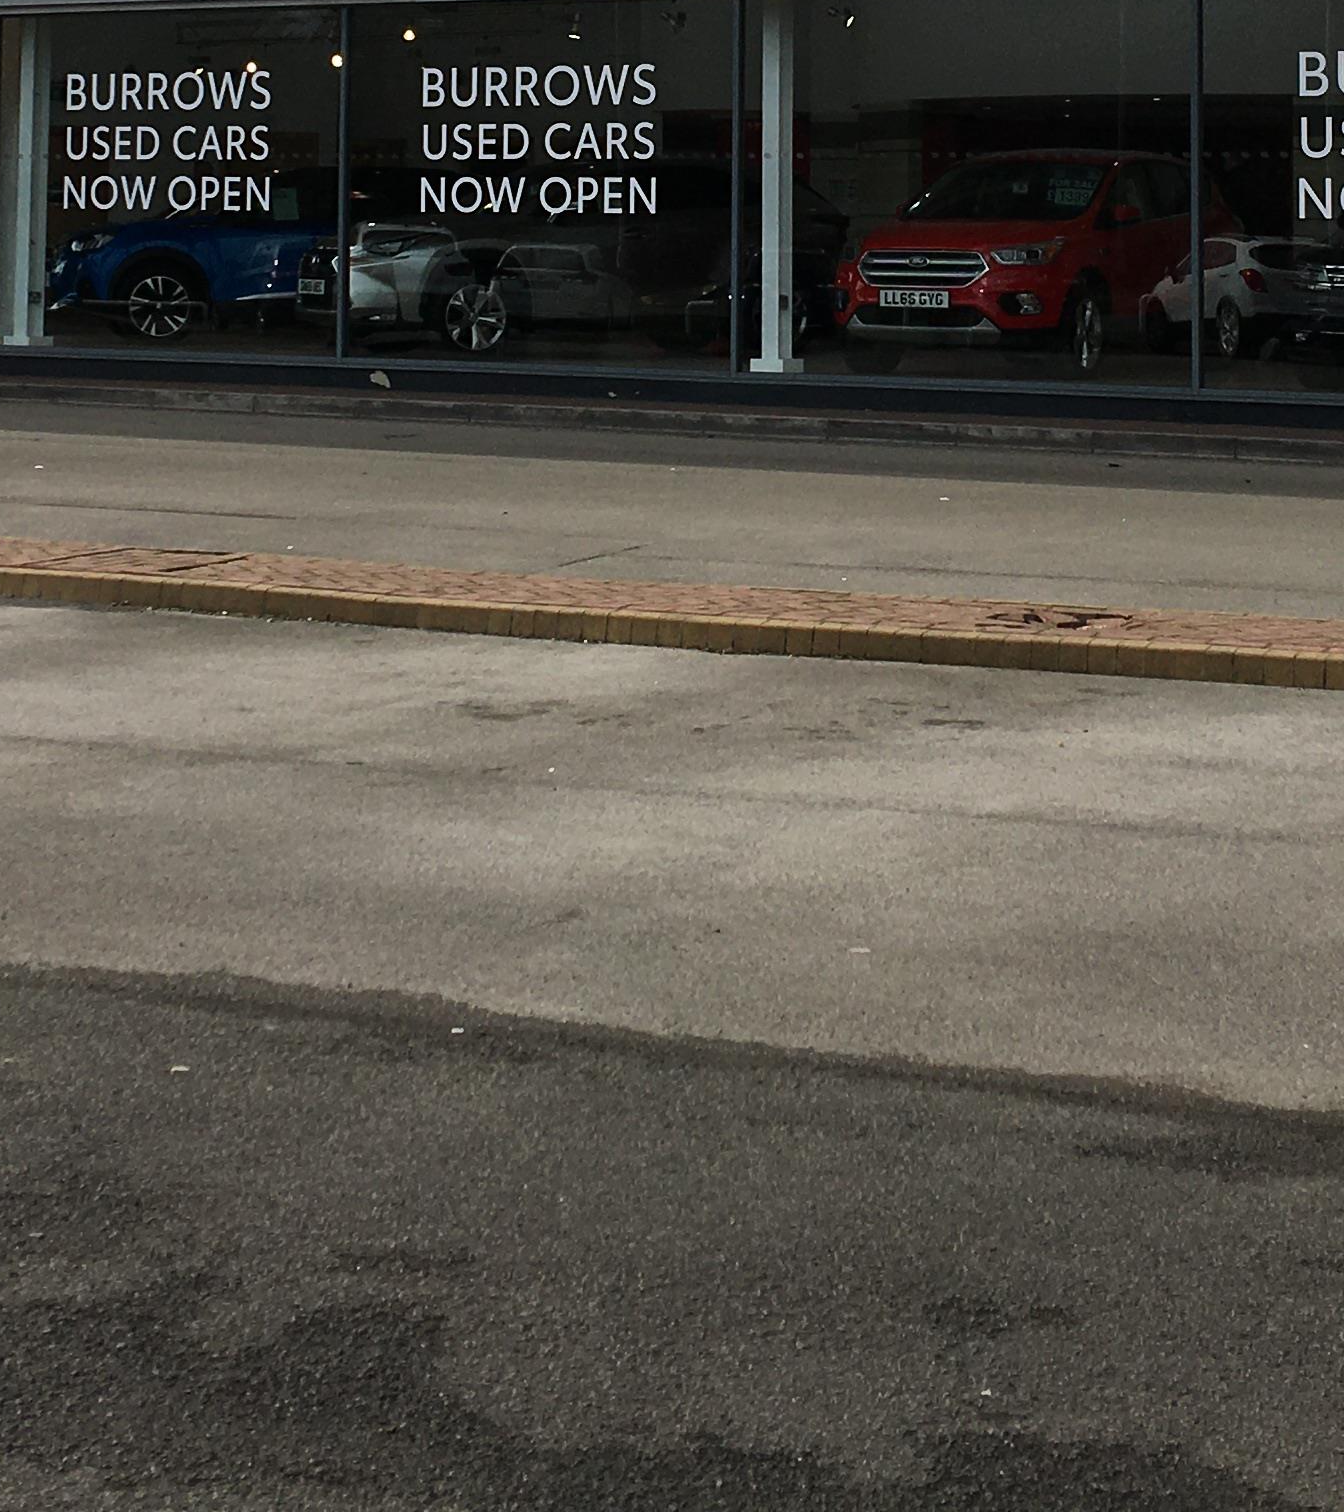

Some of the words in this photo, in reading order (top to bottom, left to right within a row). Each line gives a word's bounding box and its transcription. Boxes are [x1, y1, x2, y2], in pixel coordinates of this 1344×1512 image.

[66, 70, 272, 111] BURROWS
[421, 63, 657, 108] BURROWS
[66, 125, 160, 161] USED
[172, 125, 269, 161] CARS
[423, 123, 530, 161] USED
[544, 121, 655, 161] CARS
[63, 175, 157, 210] NOW
[167, 175, 271, 211] OPEN
[420, 176, 526, 213] NOW
[539, 176, 657, 215] OPEN
